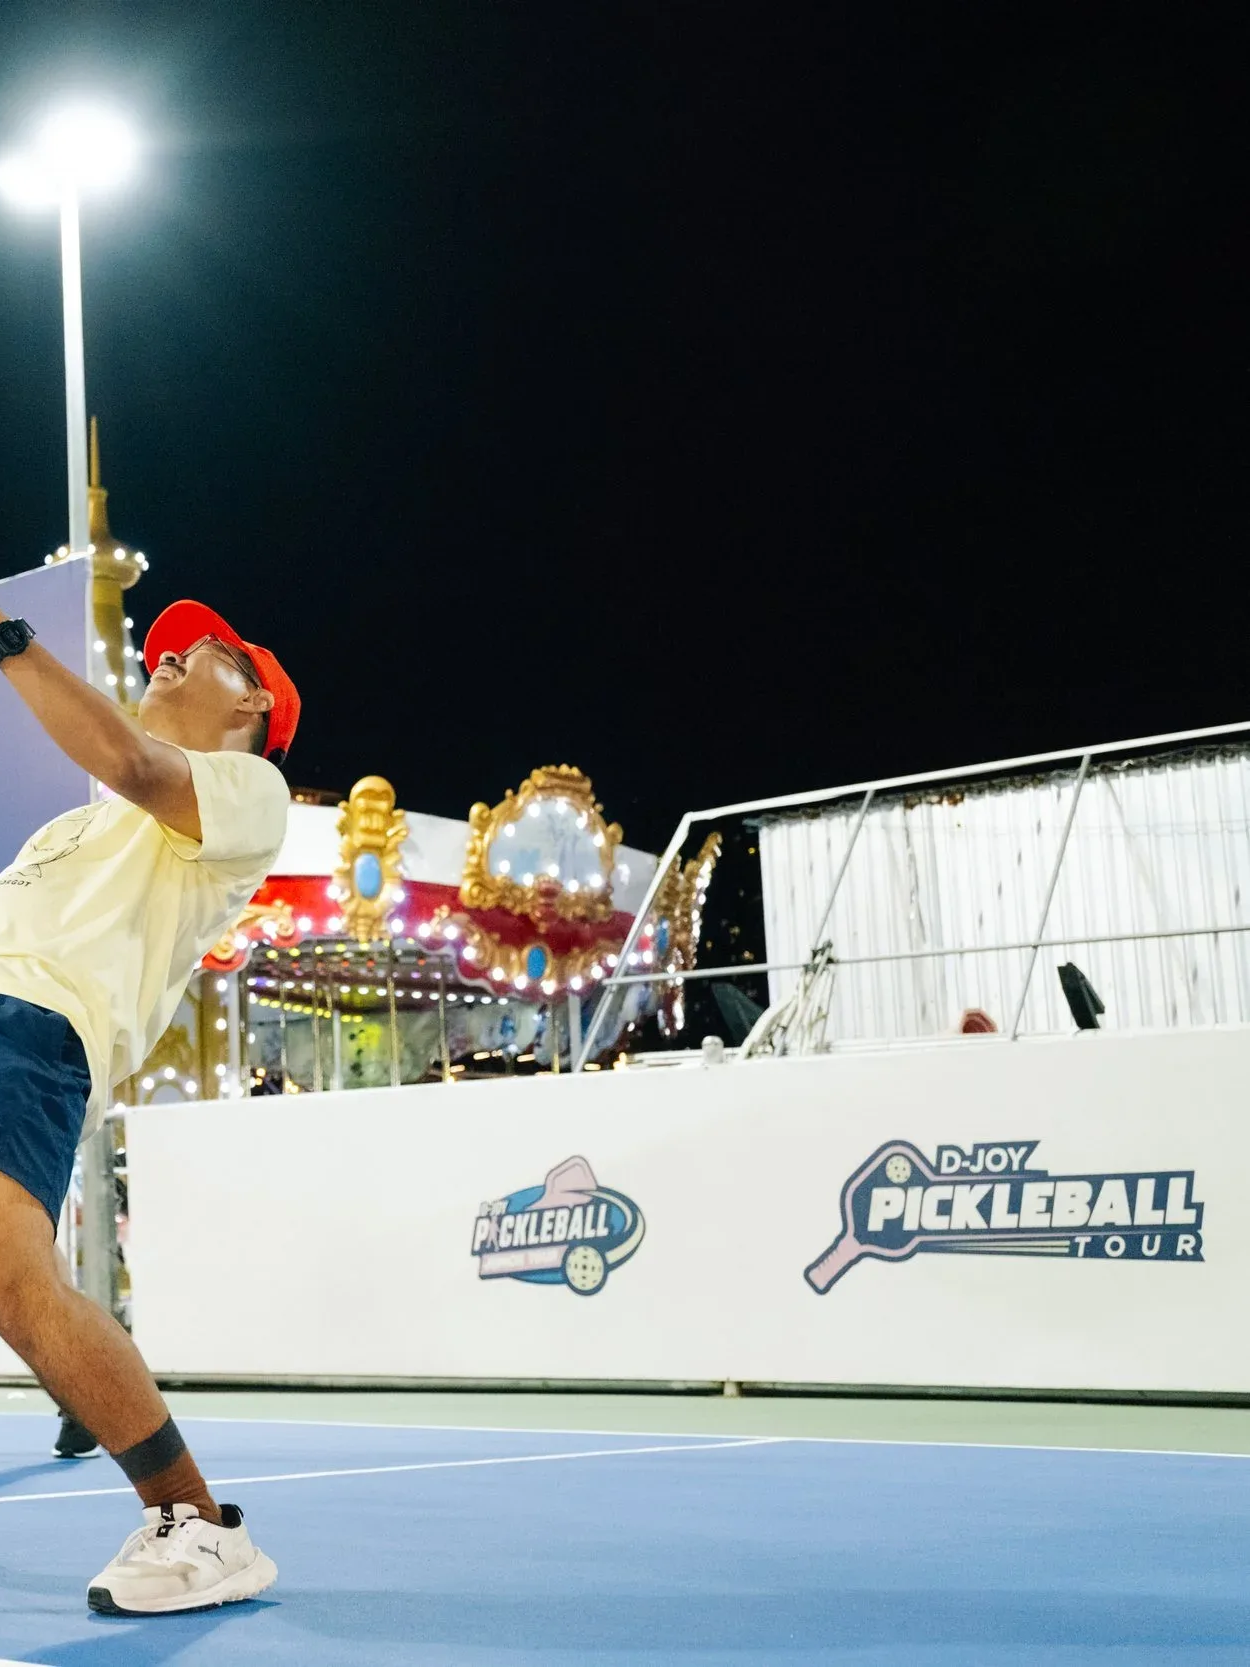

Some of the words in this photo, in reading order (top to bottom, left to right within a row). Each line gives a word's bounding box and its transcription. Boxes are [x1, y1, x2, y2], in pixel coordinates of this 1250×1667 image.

[941, 1144, 1028, 1174] D-JOY
[868, 1177, 1198, 1231] PICKLEBALL
[1075, 1236, 1197, 1258] TOUR
